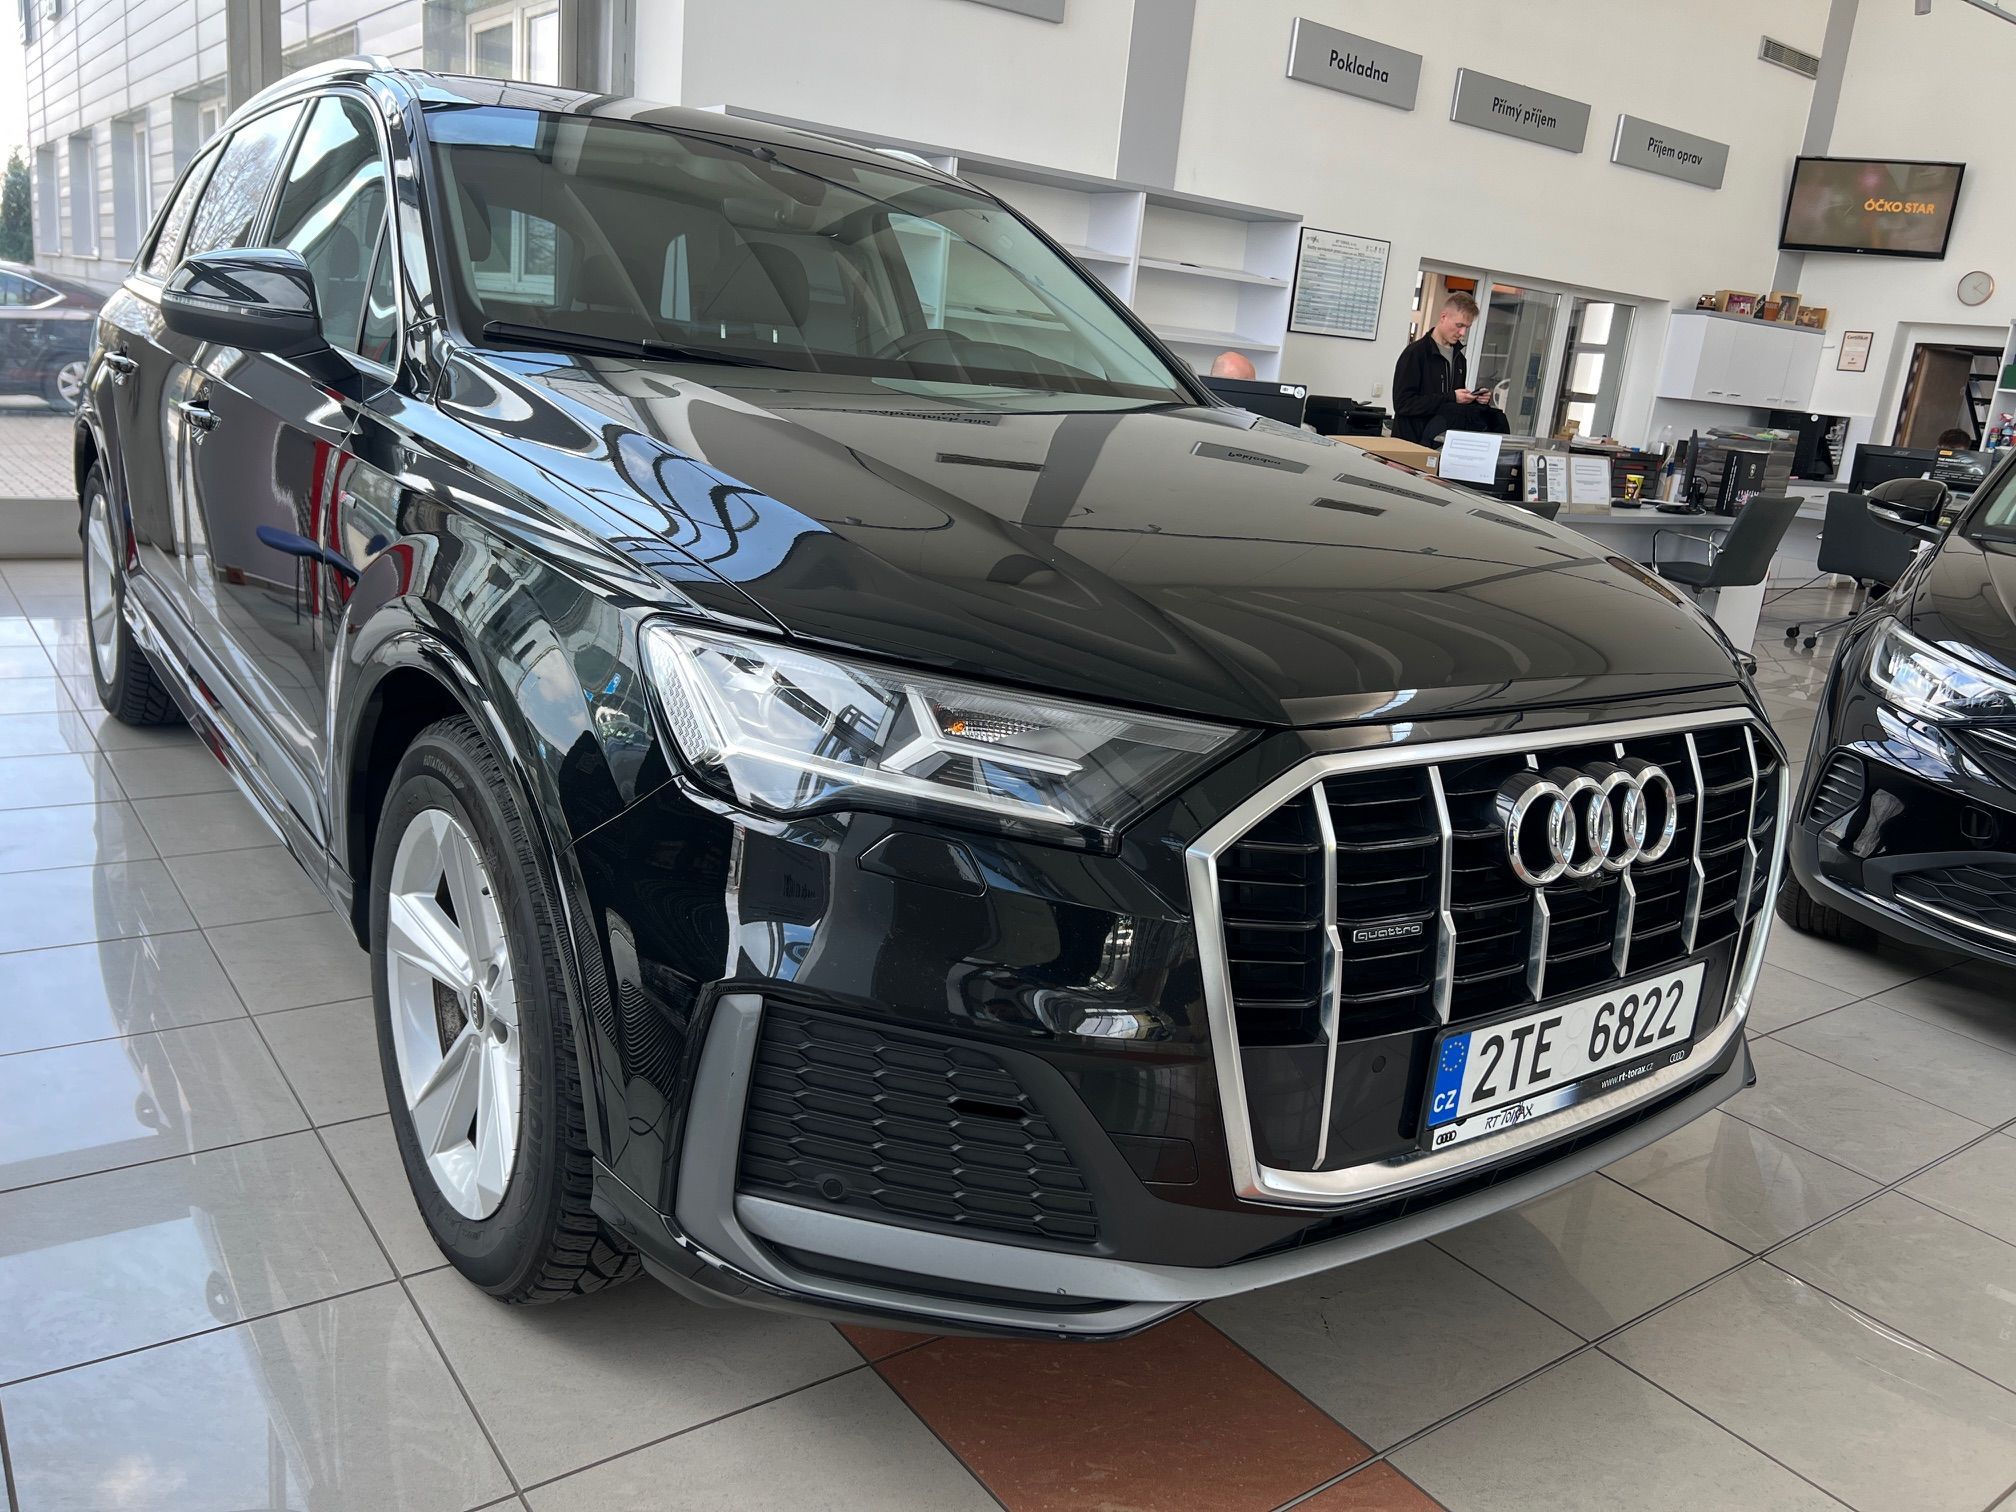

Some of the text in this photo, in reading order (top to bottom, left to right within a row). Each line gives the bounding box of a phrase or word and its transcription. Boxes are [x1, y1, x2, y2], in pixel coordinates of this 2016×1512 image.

[1329, 49, 1389, 83] Pokladna
[1492, 96, 1557, 128] Přímý příjem
[1647, 137, 1703, 165] Příjem oprav
[1864, 199, 1936, 214] ÓČKO STAR
[1357, 925, 1420, 941] quattro
[1471, 979, 1684, 1103] 2TE 6822
[1601, 1062, 1654, 1088] www.rt-torax.cz
[1433, 1089, 1457, 1113] CZ
[1484, 1114, 1502, 1130] RT
